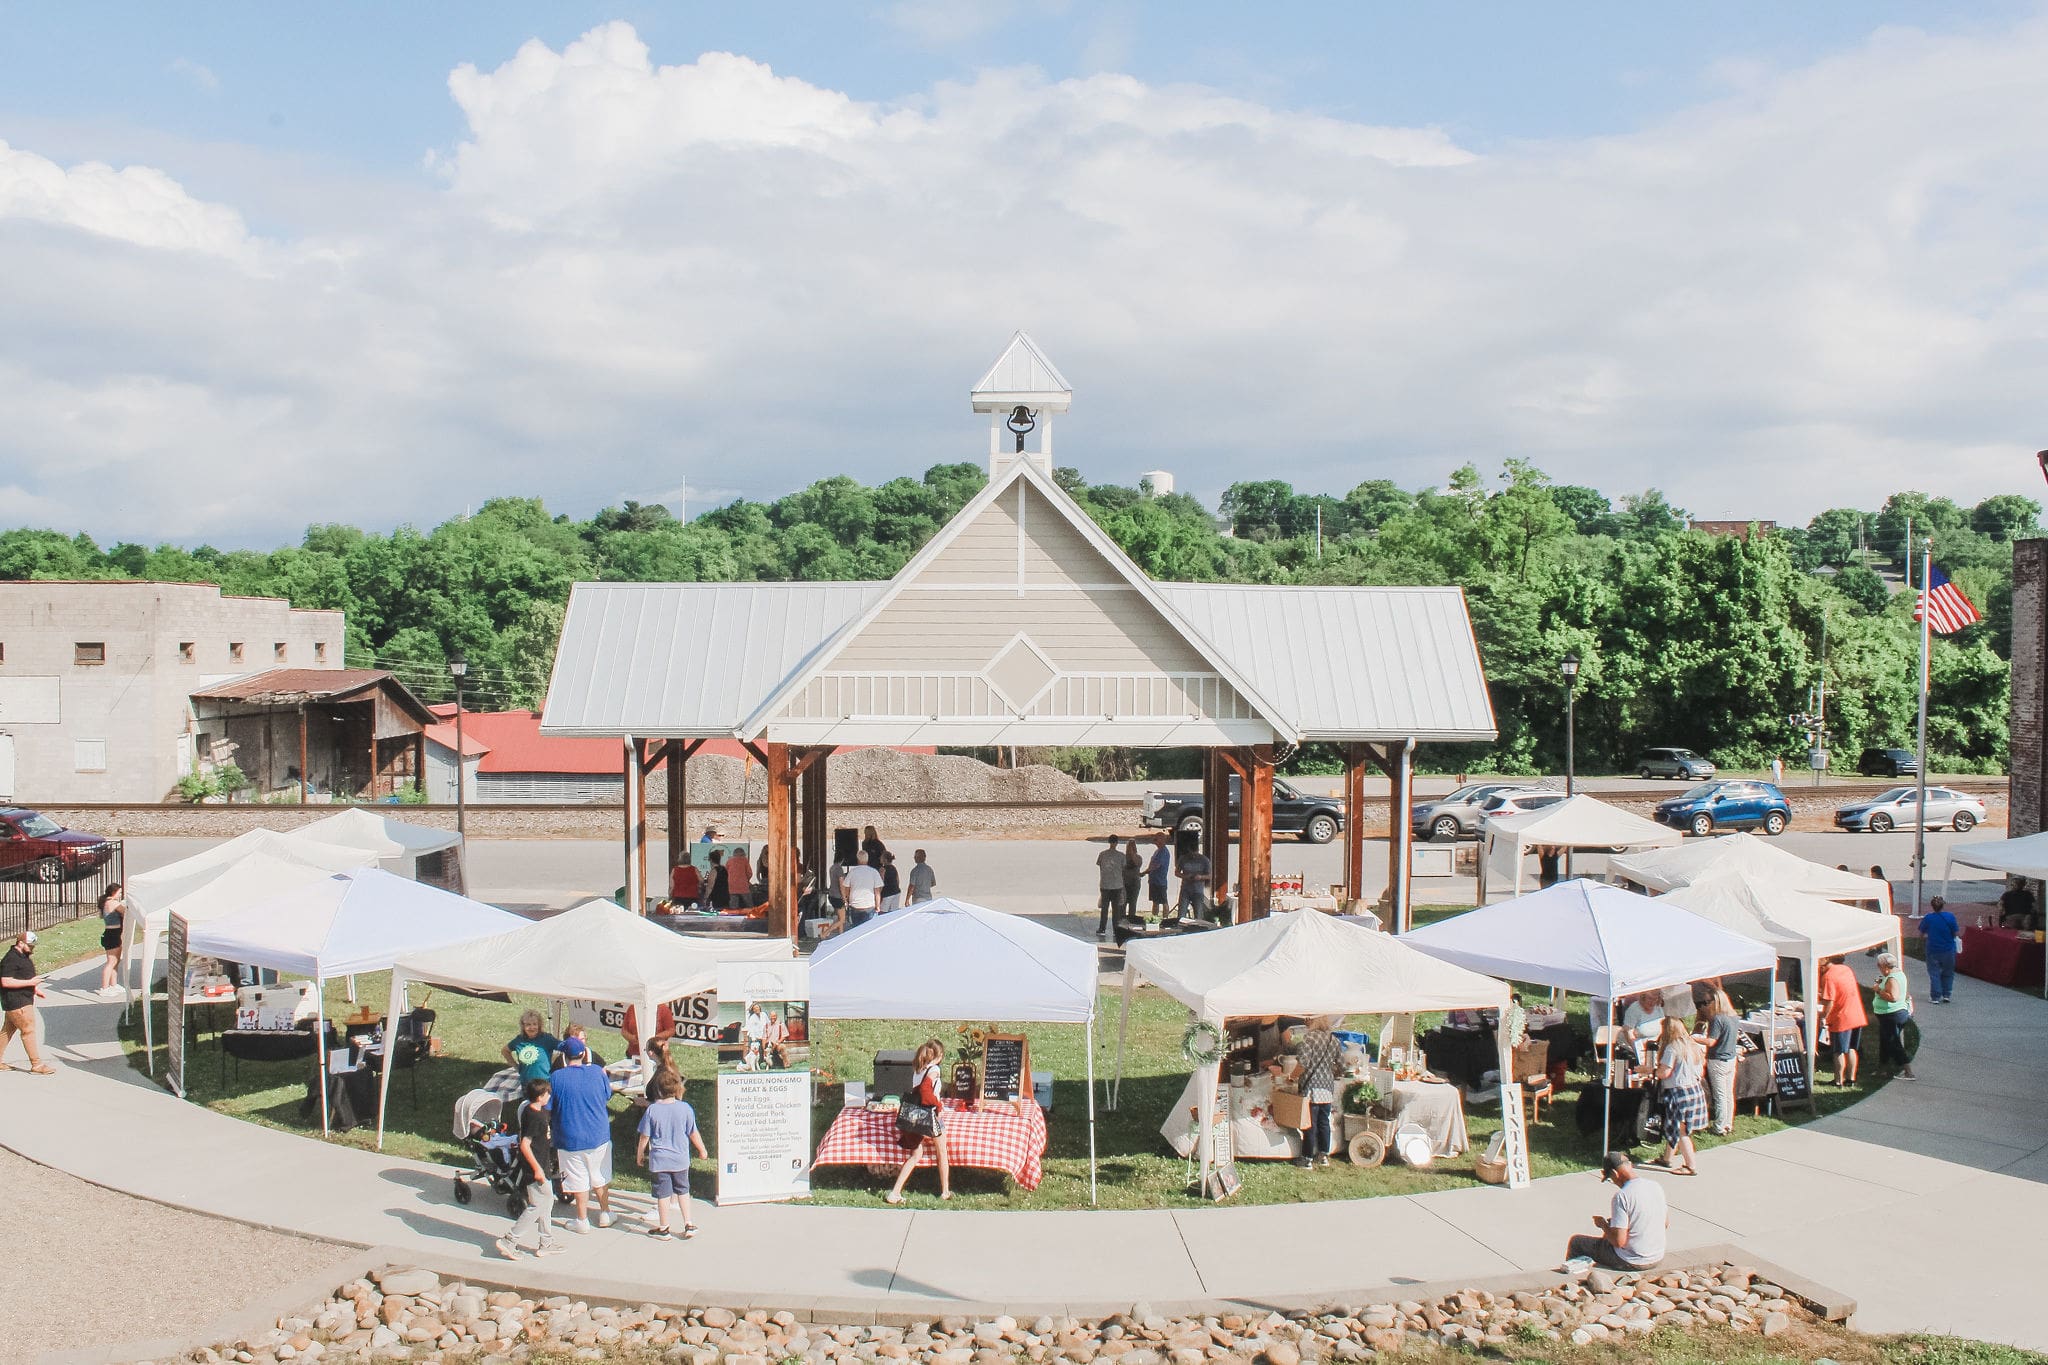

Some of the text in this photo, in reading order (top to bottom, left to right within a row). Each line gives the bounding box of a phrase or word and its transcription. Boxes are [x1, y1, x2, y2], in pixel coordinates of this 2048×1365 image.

[674, 1022, 719, 1041] 0610
[734, 1095, 770, 1103] Fresh Eggs
